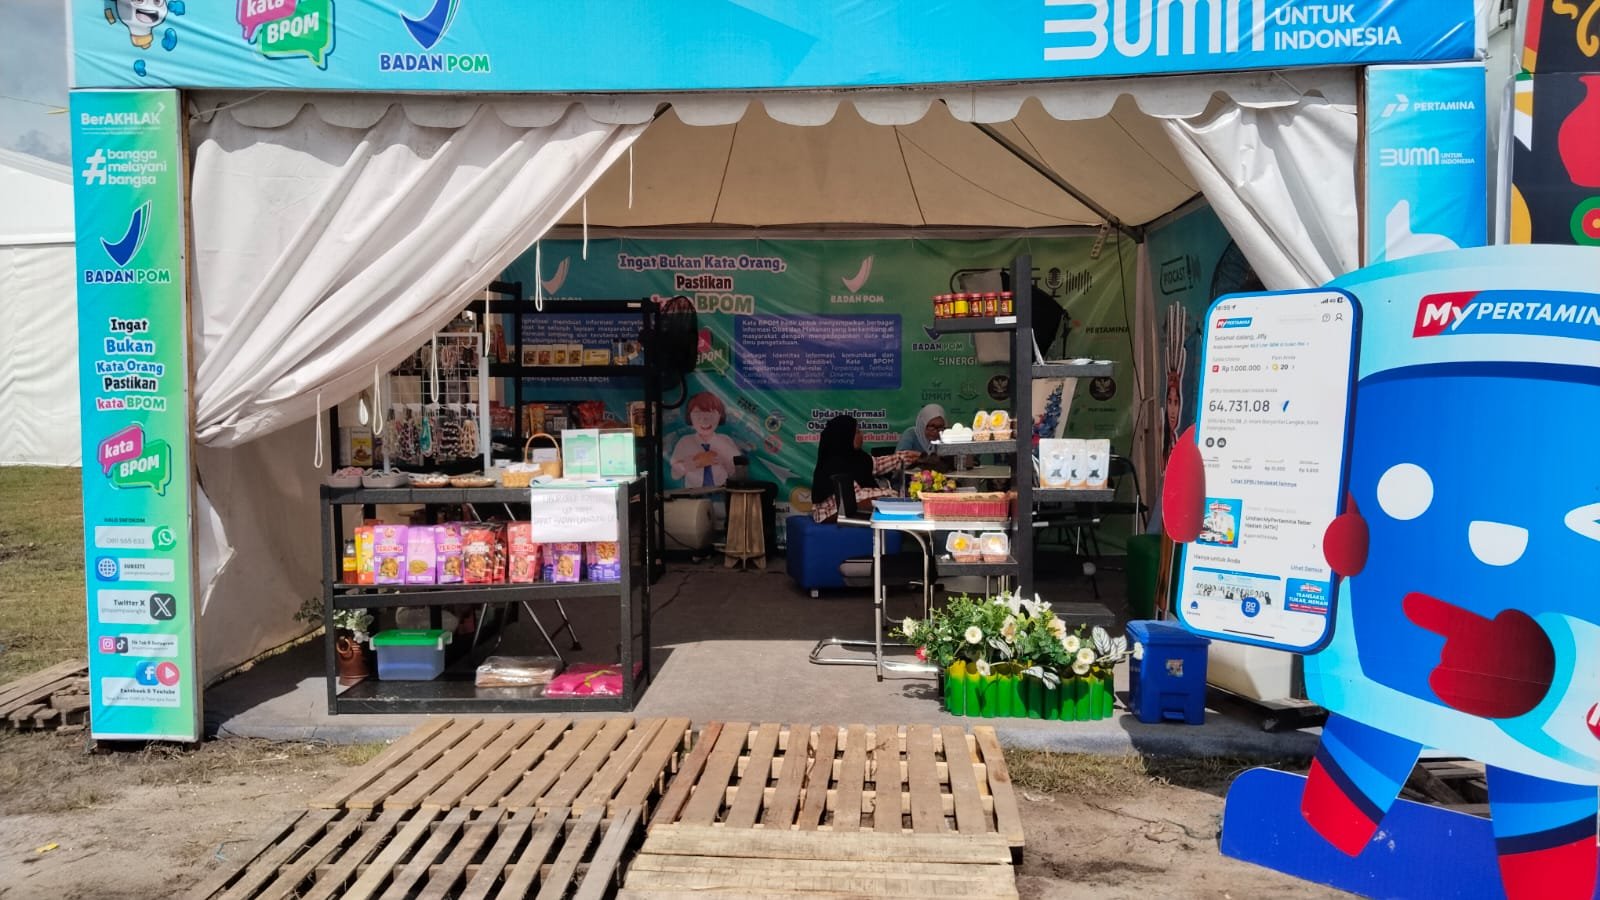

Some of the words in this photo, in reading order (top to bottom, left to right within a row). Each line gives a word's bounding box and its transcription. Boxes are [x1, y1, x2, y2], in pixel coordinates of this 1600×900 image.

[1275, 4, 1355, 26] UNTUK
[266, 12, 320, 44] BPOM
[1275, 27, 1402, 51] INDONESIA
[380, 54, 442, 71] BADAN
[447, 54, 491, 72] POM
[1413, 101, 1476, 112] PERTAMINA
[81, 111, 161, 125] BerAKHLAK
[107, 149, 158, 162] bangga
[108, 160, 167, 175] melayani
[108, 175, 157, 188] bangsa
[619, 254, 657, 271] Ingat
[659, 255, 701, 270] Bukan
[703, 255, 736, 270] Kata
[738, 255, 787, 273] Orang,
[85, 270, 134, 283] BADAN
[137, 270, 171, 283] POM
[675, 274, 733, 290] Pastikan
[695, 294, 755, 313] BPOM
[830, 295, 862, 304] BADAN
[862, 295, 885, 304] POM
[110, 318, 148, 334] Ingat
[105, 338, 154, 353] Bukan
[912, 343, 942, 352] BADAN
[96, 361, 125, 373] Kata
[127, 360, 164, 376] Orang
[104, 375, 157, 391] Pastikan
[97, 398, 125, 410] kata
[126, 396, 166, 410] BPOM
[1208, 400, 1270, 412] 64.731.08
[104, 440, 135, 459] kata
[119, 454, 160, 478] BPOM
[114, 599, 139, 607] Twitter
